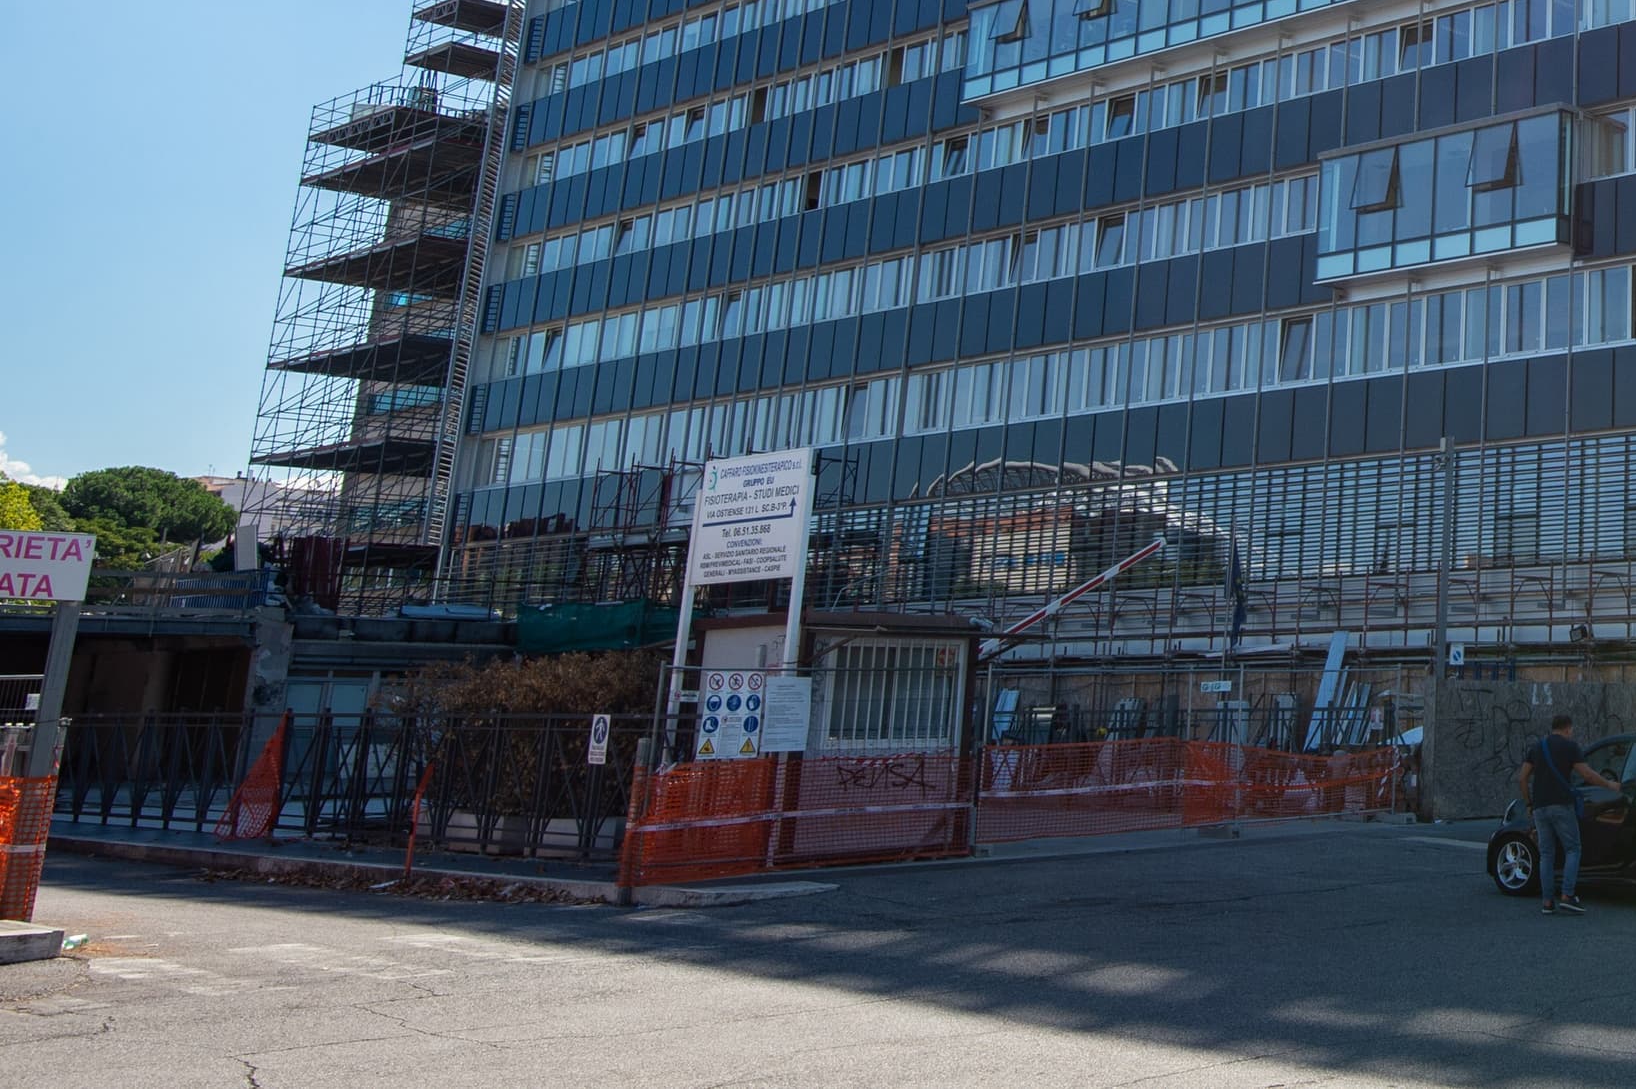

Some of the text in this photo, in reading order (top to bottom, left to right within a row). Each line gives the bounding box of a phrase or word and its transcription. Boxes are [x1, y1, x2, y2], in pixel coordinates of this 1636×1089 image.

[720, 465, 741, 479] CAFFARO
[743, 477, 764, 487] GRUPPO
[704, 491, 748, 506] FISIOTERAPIA
[753, 488, 773, 500] STUDI
[774, 485, 799, 497] MEDICI
[706, 510, 715, 519] VIA
[715, 507, 744, 518] OSTIENSE
[722, 528, 731, 538] Tel.
[703, 552, 712, 560] ASL
[715, 550, 734, 559] SERVIZIO
[735, 547, 759, 557] SANITARIO
[759, 545, 786, 555] REGIONALE
[704, 569, 725, 578] GENERALI
